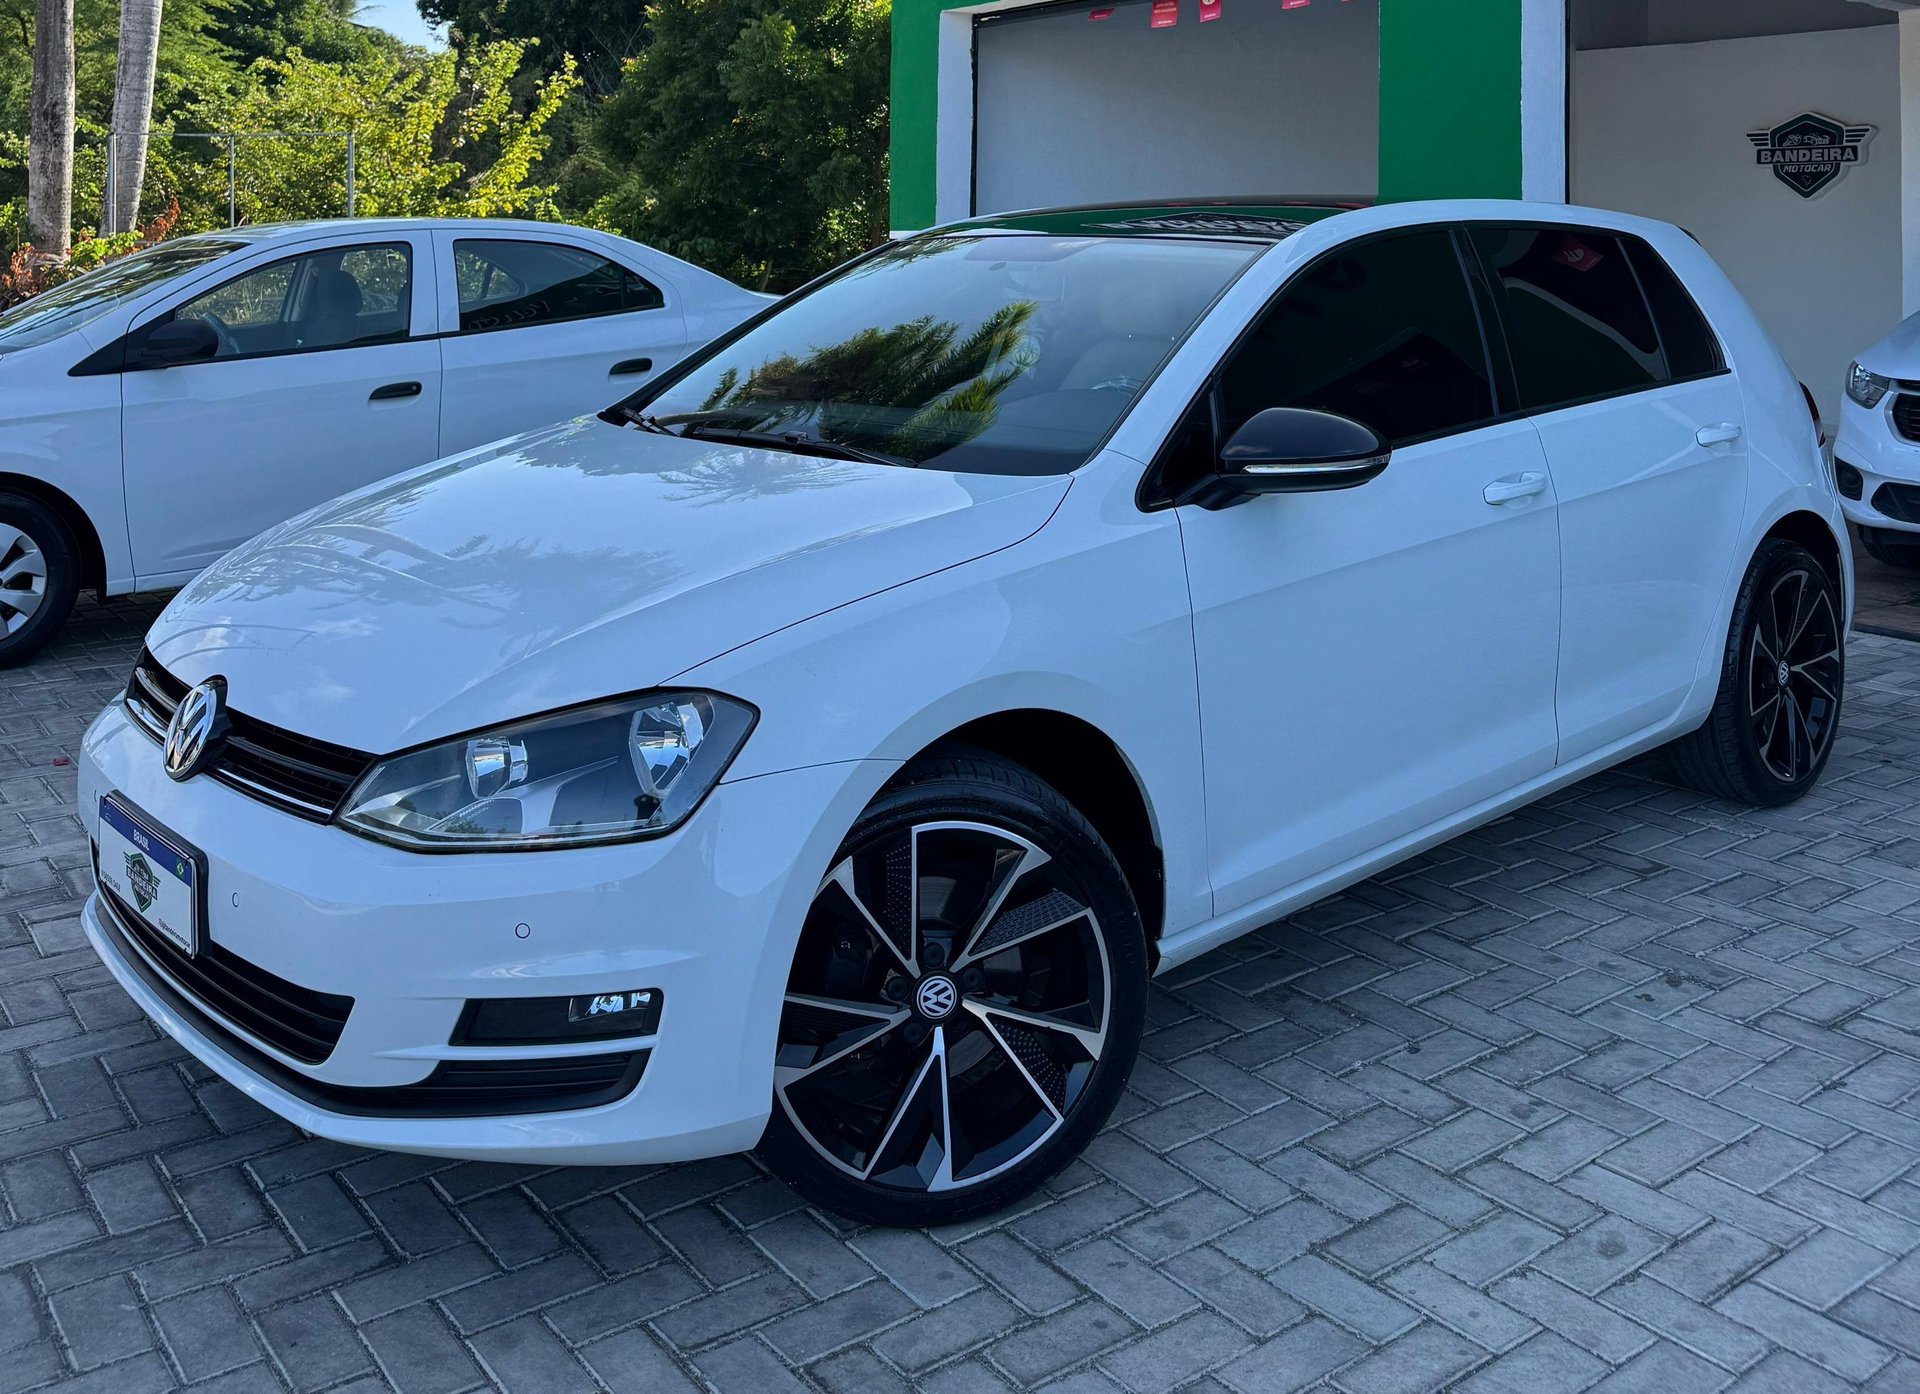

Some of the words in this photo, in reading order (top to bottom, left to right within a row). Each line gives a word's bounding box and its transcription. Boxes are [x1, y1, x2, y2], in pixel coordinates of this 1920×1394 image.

[1760, 148, 1855, 163] BANDEIRA
[1782, 164, 1832, 173] MOTOCAR
[133, 829, 150, 851] BRASIL
